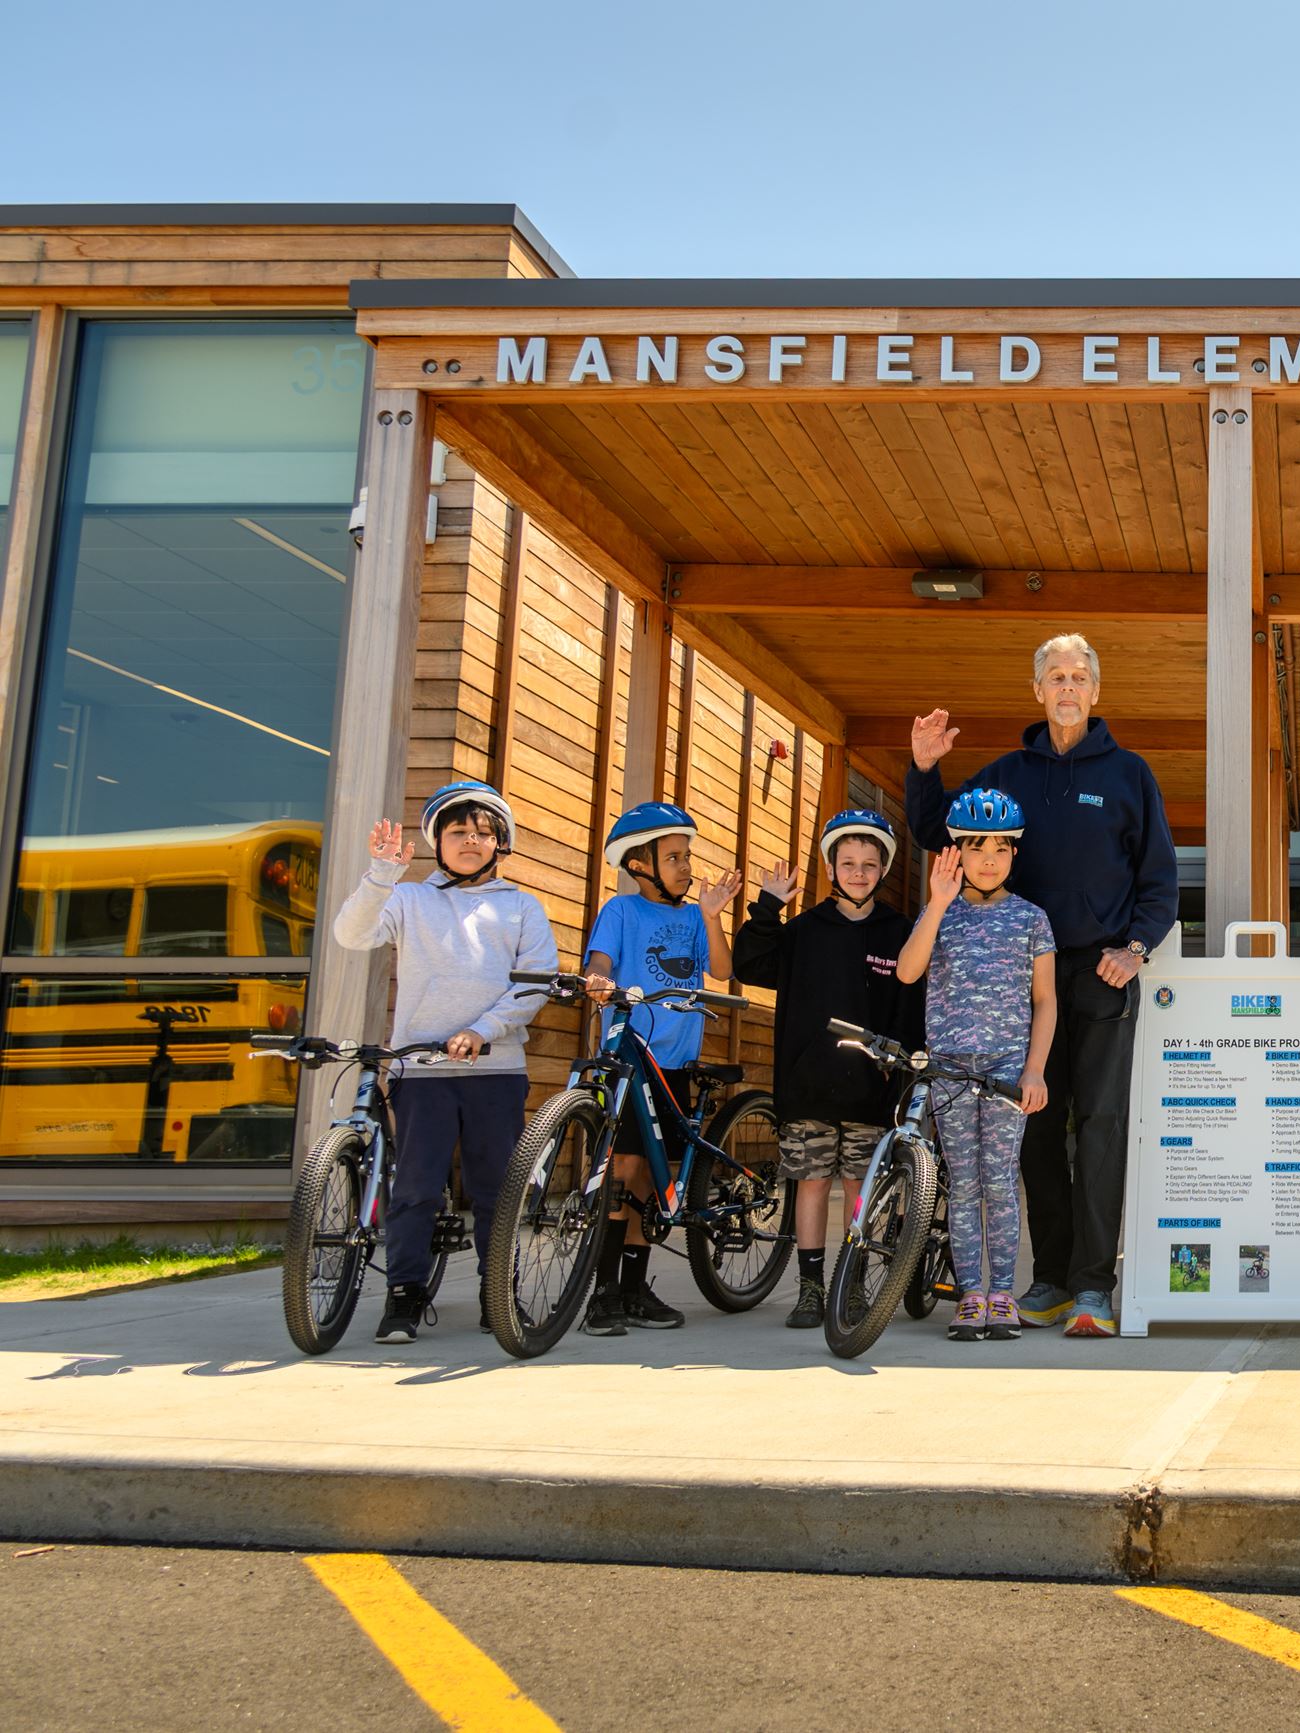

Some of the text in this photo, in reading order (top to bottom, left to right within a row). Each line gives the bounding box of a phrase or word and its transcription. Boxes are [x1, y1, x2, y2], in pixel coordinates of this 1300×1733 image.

[291, 342, 363, 396] 35
[496, 335, 1042, 384] MANSFIELD
[646, 956, 694, 989] GOODWIN
[1232, 996, 1264, 1007] BIKE
[1163, 1039, 1183, 1048] DAY
[1185, 1039, 1191, 1048] 1
[1199, 1039, 1214, 1048] 4th
[1216, 1039, 1251, 1048] GRADE
[1253, 1039, 1277, 1048] BIKE
